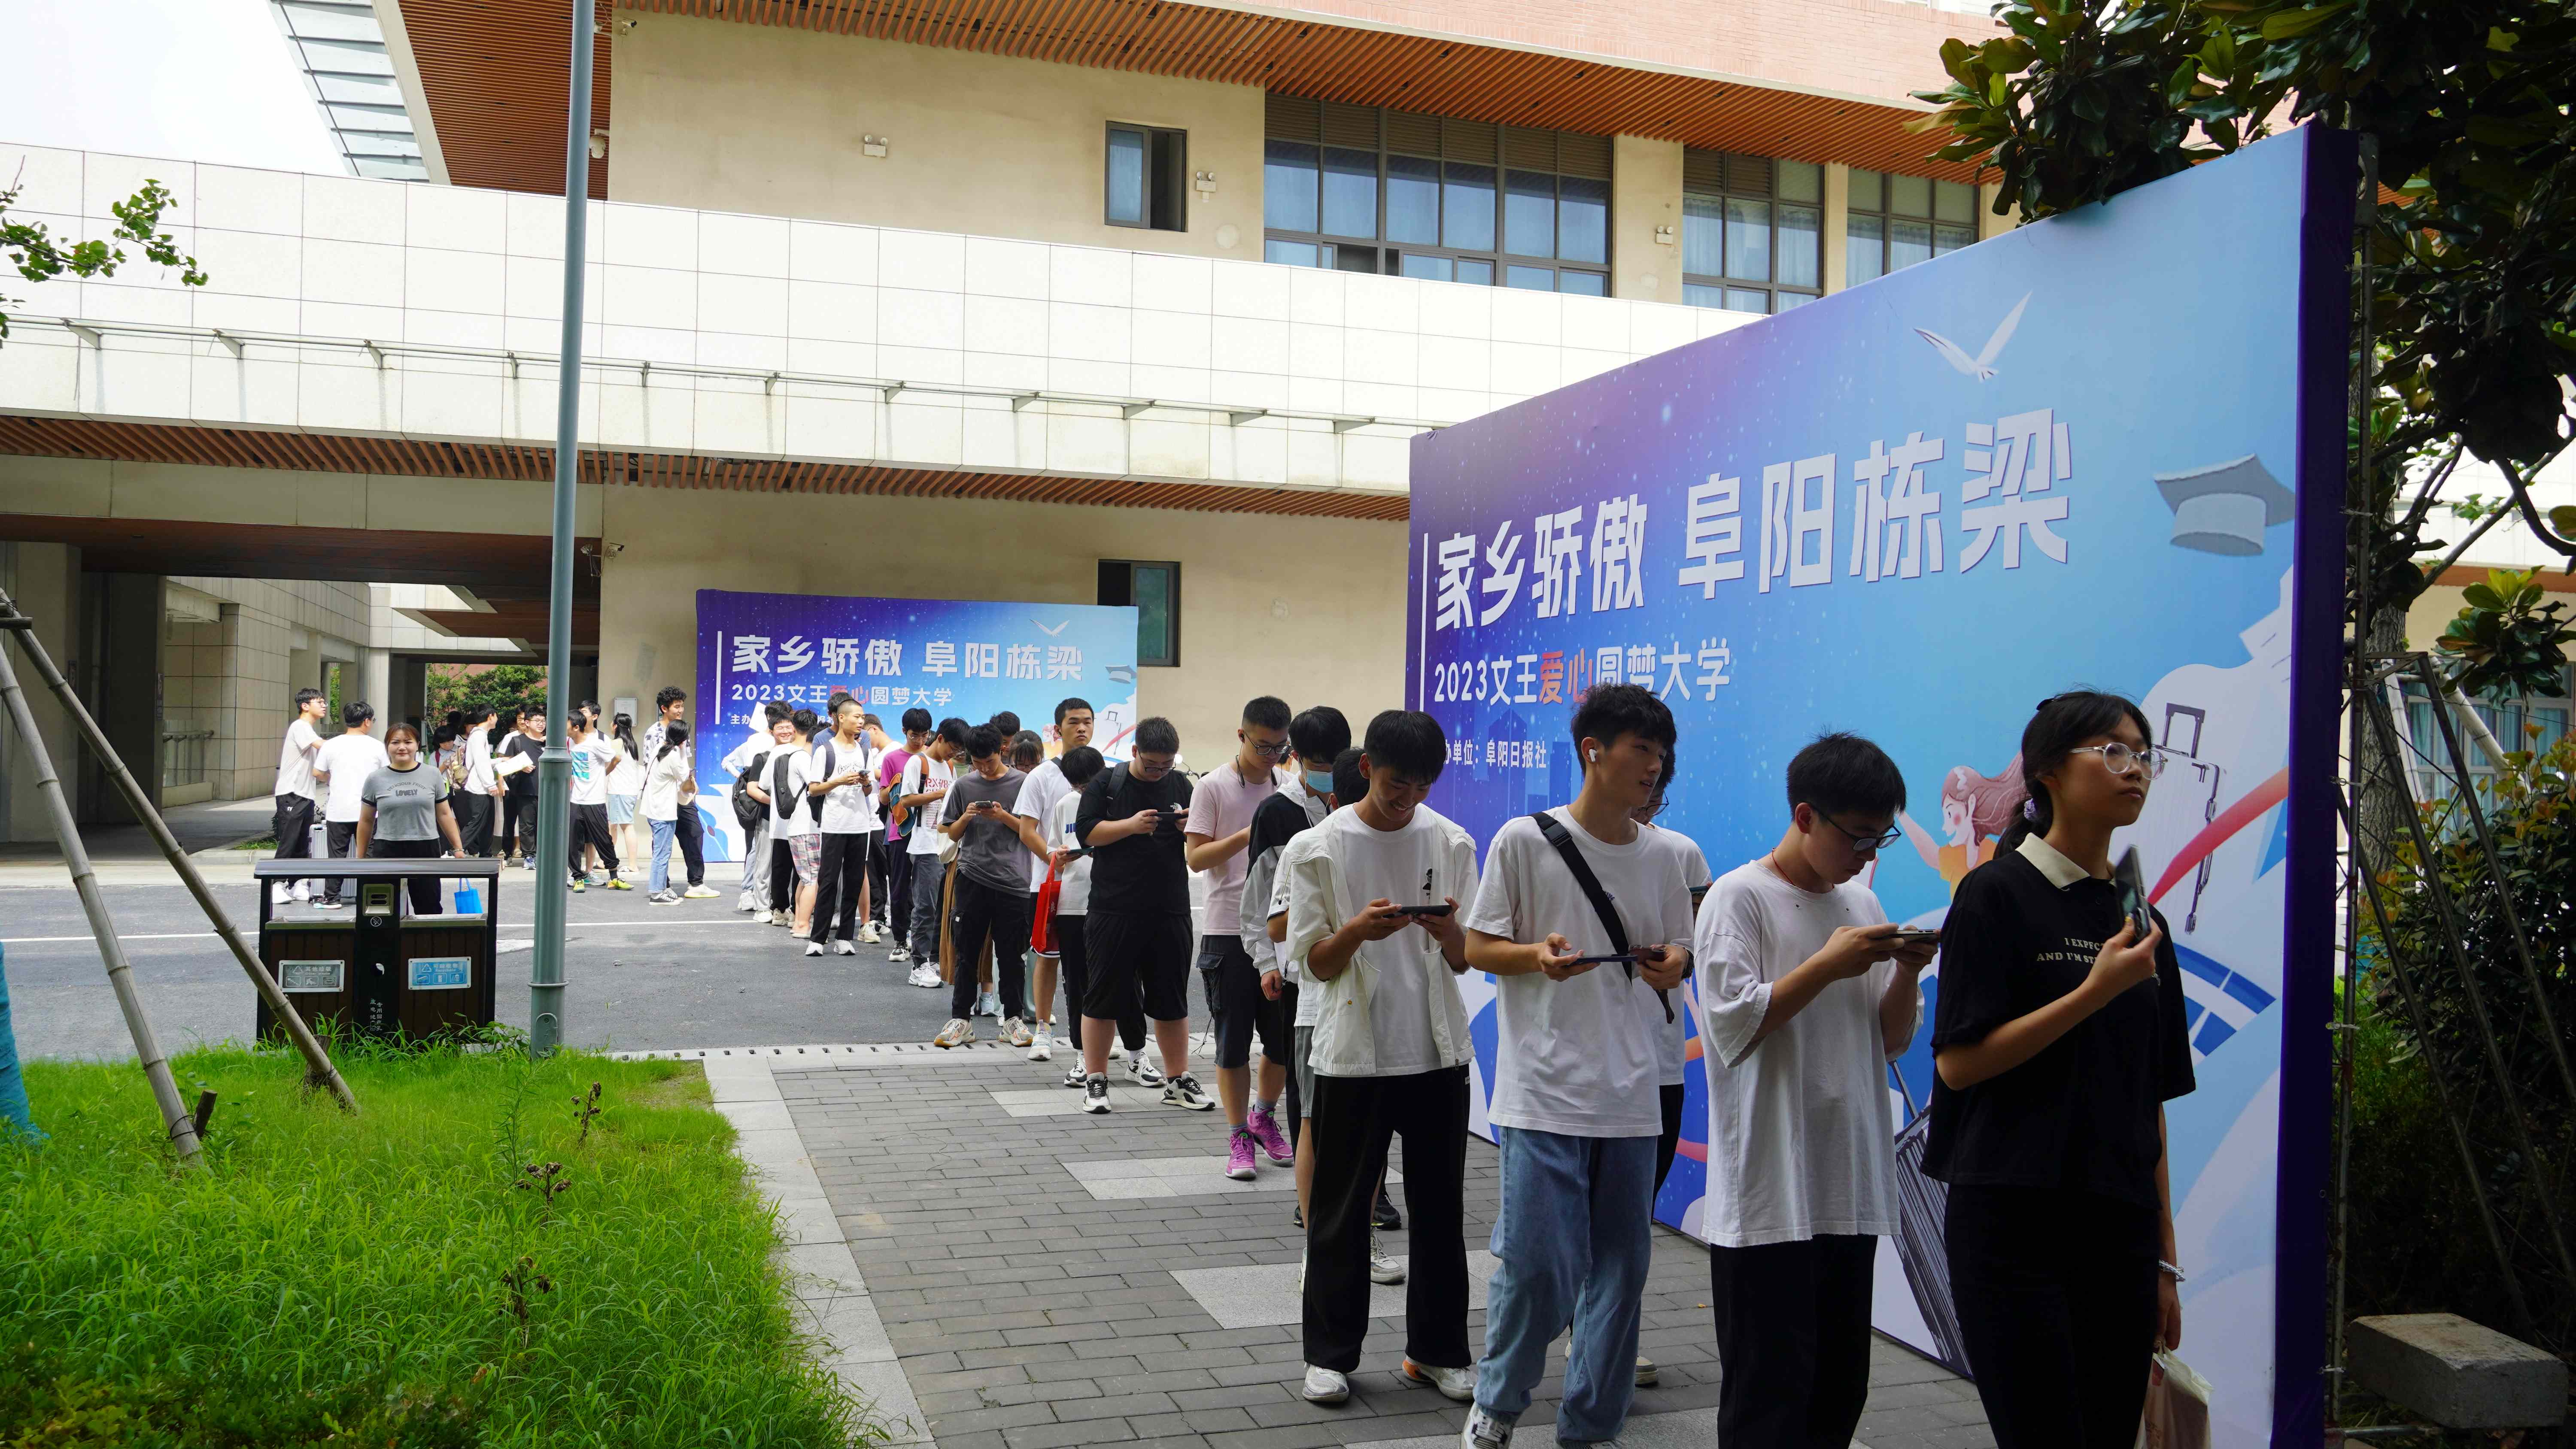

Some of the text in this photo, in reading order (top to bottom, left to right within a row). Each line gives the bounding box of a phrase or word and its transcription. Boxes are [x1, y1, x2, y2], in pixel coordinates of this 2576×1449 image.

[1436, 407, 2072, 631] 家乡骄傲 阜阳栋梁
[732, 634, 1084, 682] 家乡骄傲 阜阳栋梁
[1434, 637, 1731, 705] 2023文王爱心圆梦大学
[2037, 952, 2063, 961] AND
[2066, 953, 2082, 961] I'M
